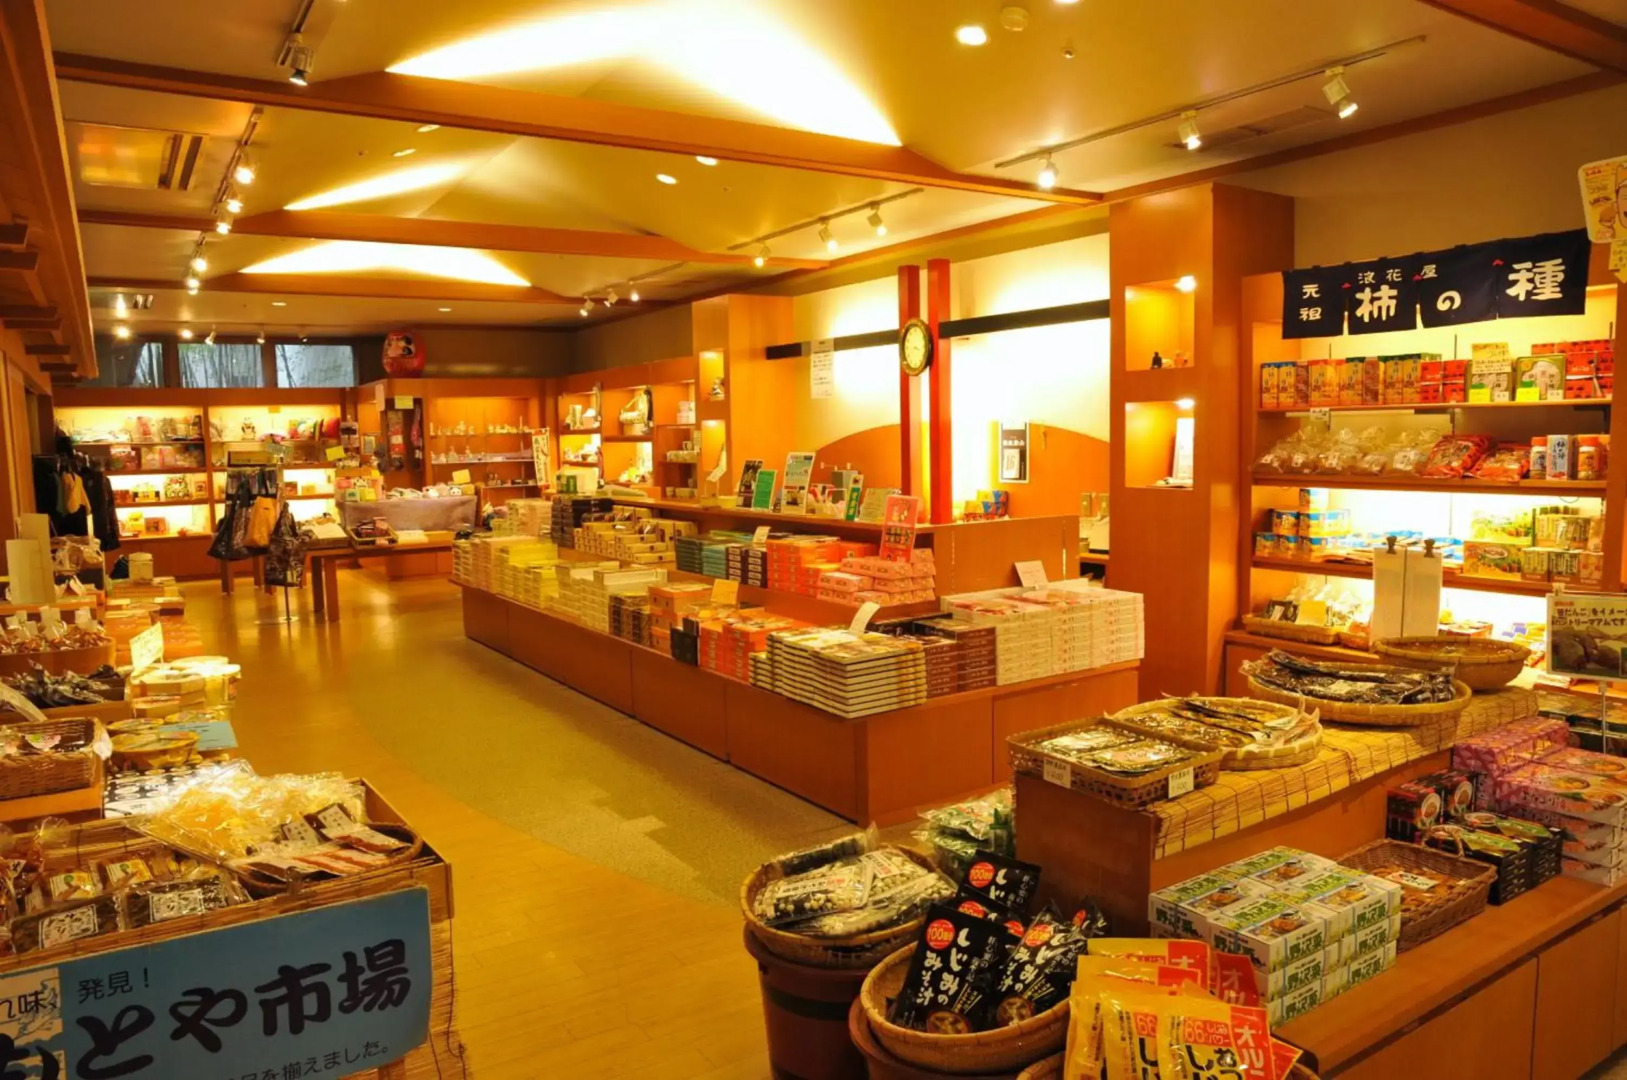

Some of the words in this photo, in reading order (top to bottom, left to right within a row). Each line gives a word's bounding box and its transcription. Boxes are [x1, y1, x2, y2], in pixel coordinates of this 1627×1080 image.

[1355, 258, 1567, 323] 柿の種
[1358, 264, 1438, 286] 浪花屋
[1299, 283, 1322, 322] 元祖
[937, 927, 971, 1005] しじみの
[1185, 1020, 1206, 1043] 66
